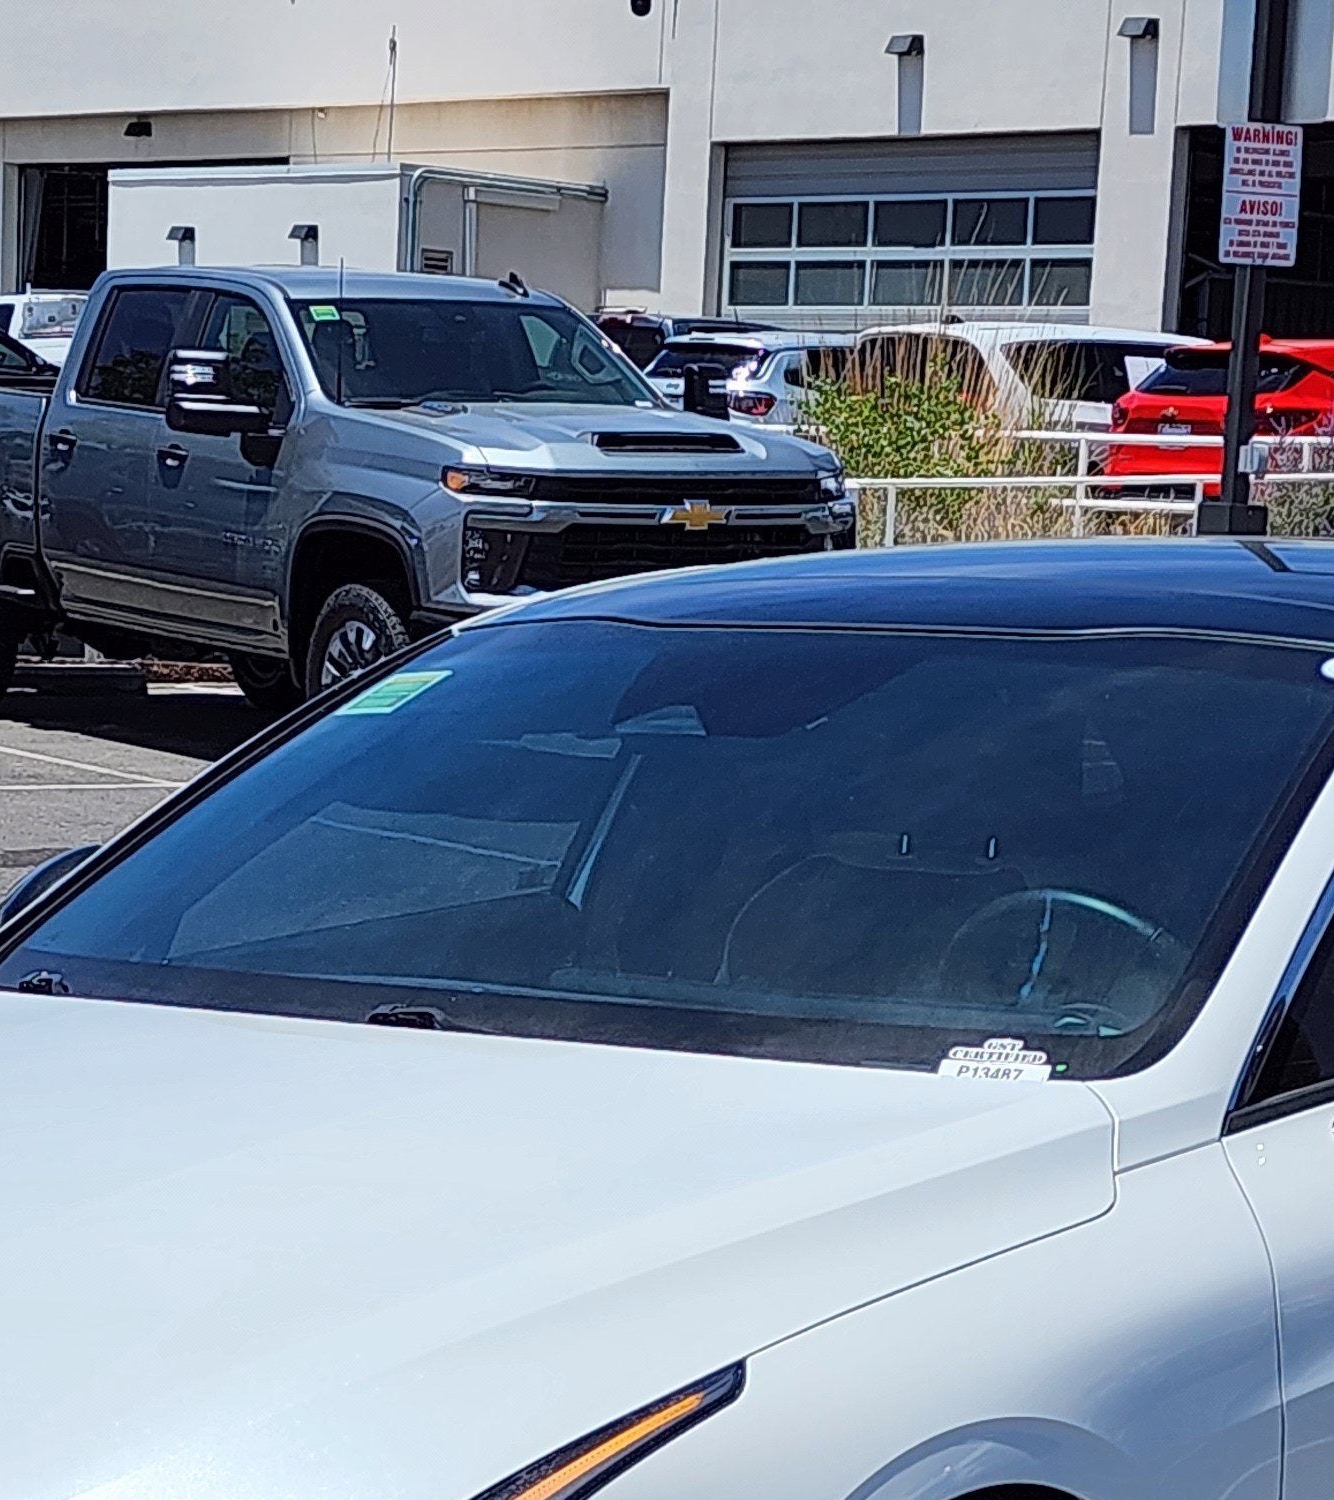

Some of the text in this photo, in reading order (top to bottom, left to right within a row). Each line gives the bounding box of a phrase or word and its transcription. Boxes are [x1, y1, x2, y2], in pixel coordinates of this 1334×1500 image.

[1231, 126, 1298, 146] WARNING!
[1239, 200, 1283, 217] AVISO!
[951, 1049, 1044, 1064] CERTIFIED
